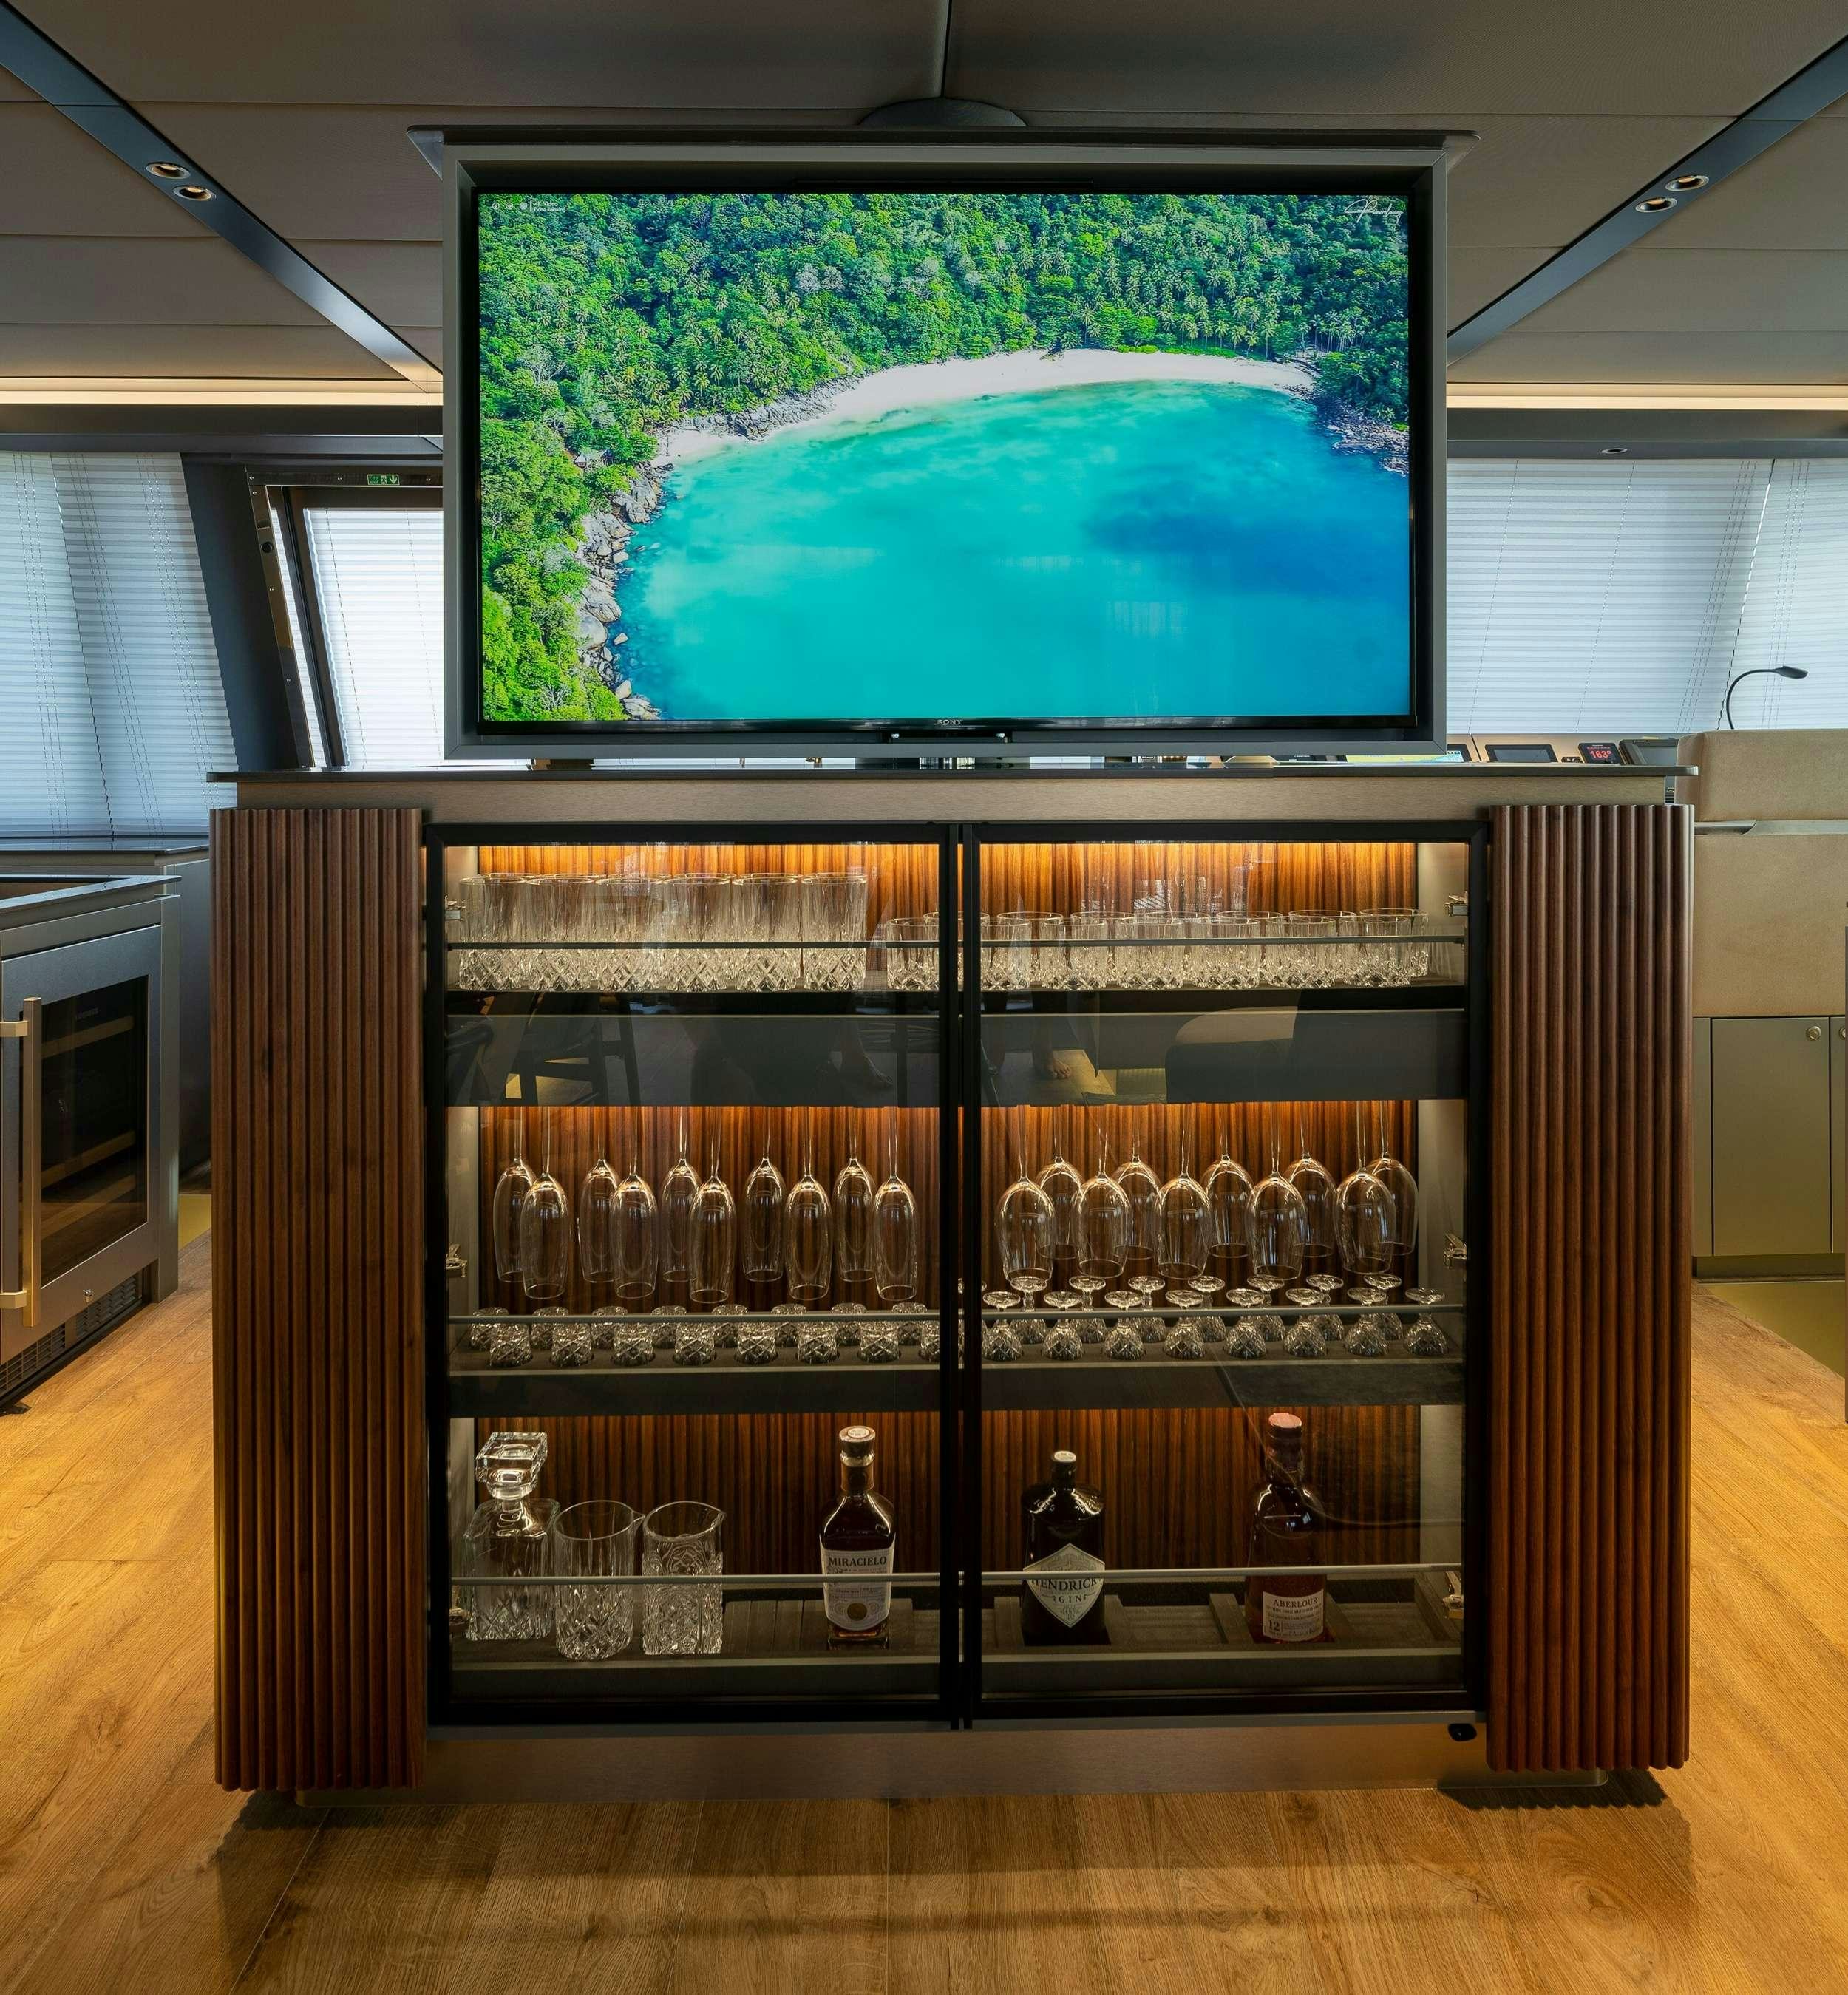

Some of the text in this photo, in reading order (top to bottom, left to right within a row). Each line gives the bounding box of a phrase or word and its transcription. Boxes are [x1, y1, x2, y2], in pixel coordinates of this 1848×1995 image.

[828, 1556, 887, 1567] MIRACIELO
[1030, 1577, 1102, 1591] HENDRICK
[1059, 1595, 1082, 1603] GIN
[1272, 1597, 1319, 1608] ABERLOUR
[1268, 1620, 1280, 1631] 12
